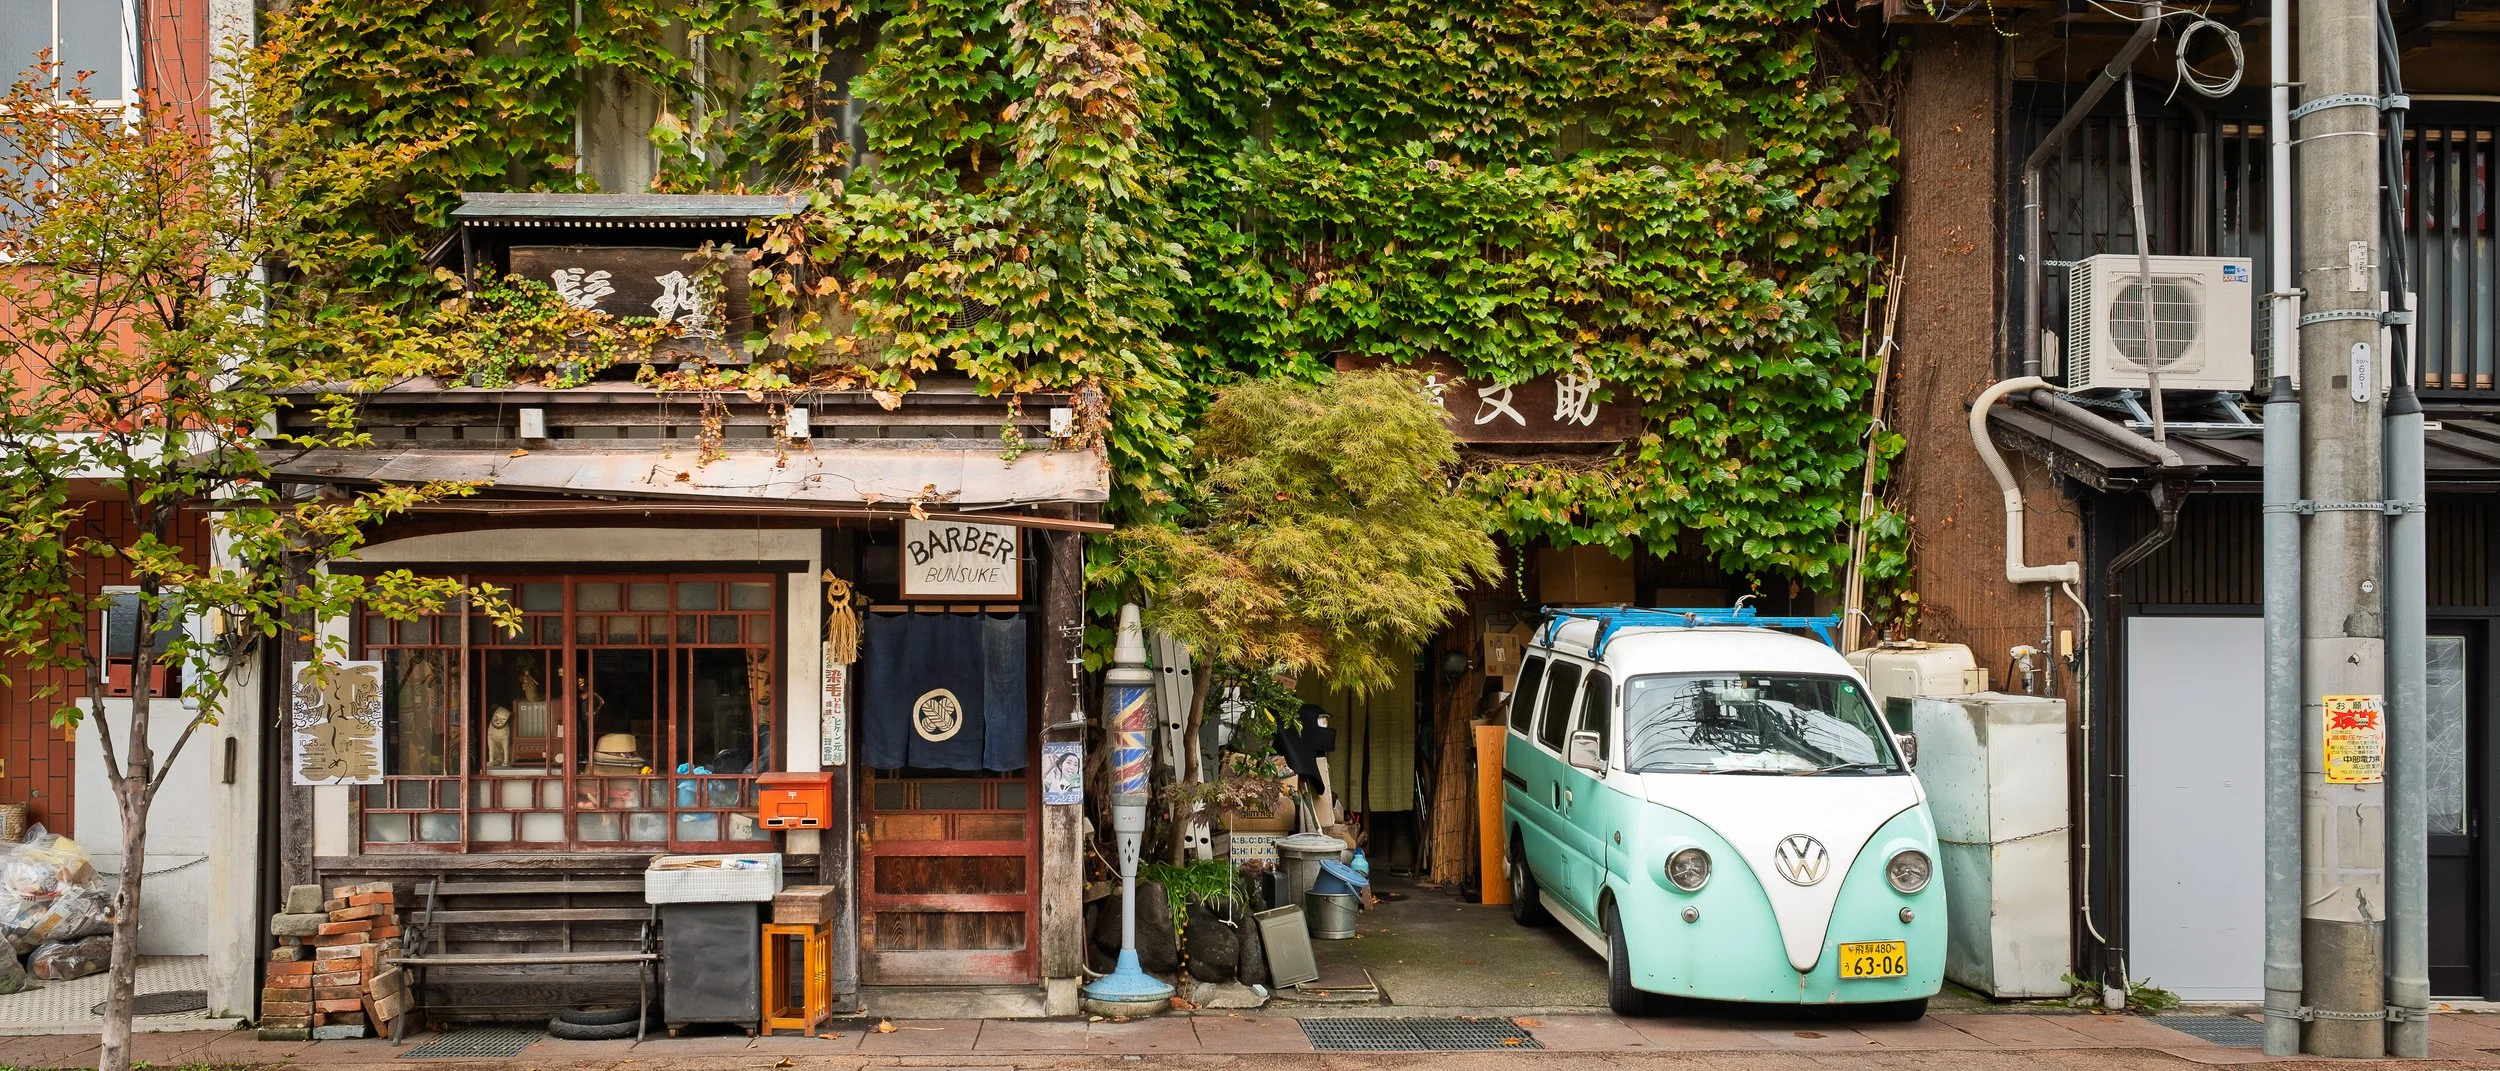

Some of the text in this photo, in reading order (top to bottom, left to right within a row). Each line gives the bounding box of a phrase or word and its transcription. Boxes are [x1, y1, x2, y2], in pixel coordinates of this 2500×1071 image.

[907, 526, 1014, 566] BARBER
[925, 564, 1000, 583] BUNSUKE
[2336, 701, 2376, 710] お願い
[1777, 836, 1826, 881] VW
[1855, 943, 1892, 954] 飛騨 480
[1845, 955, 1905, 976] う 63-06
